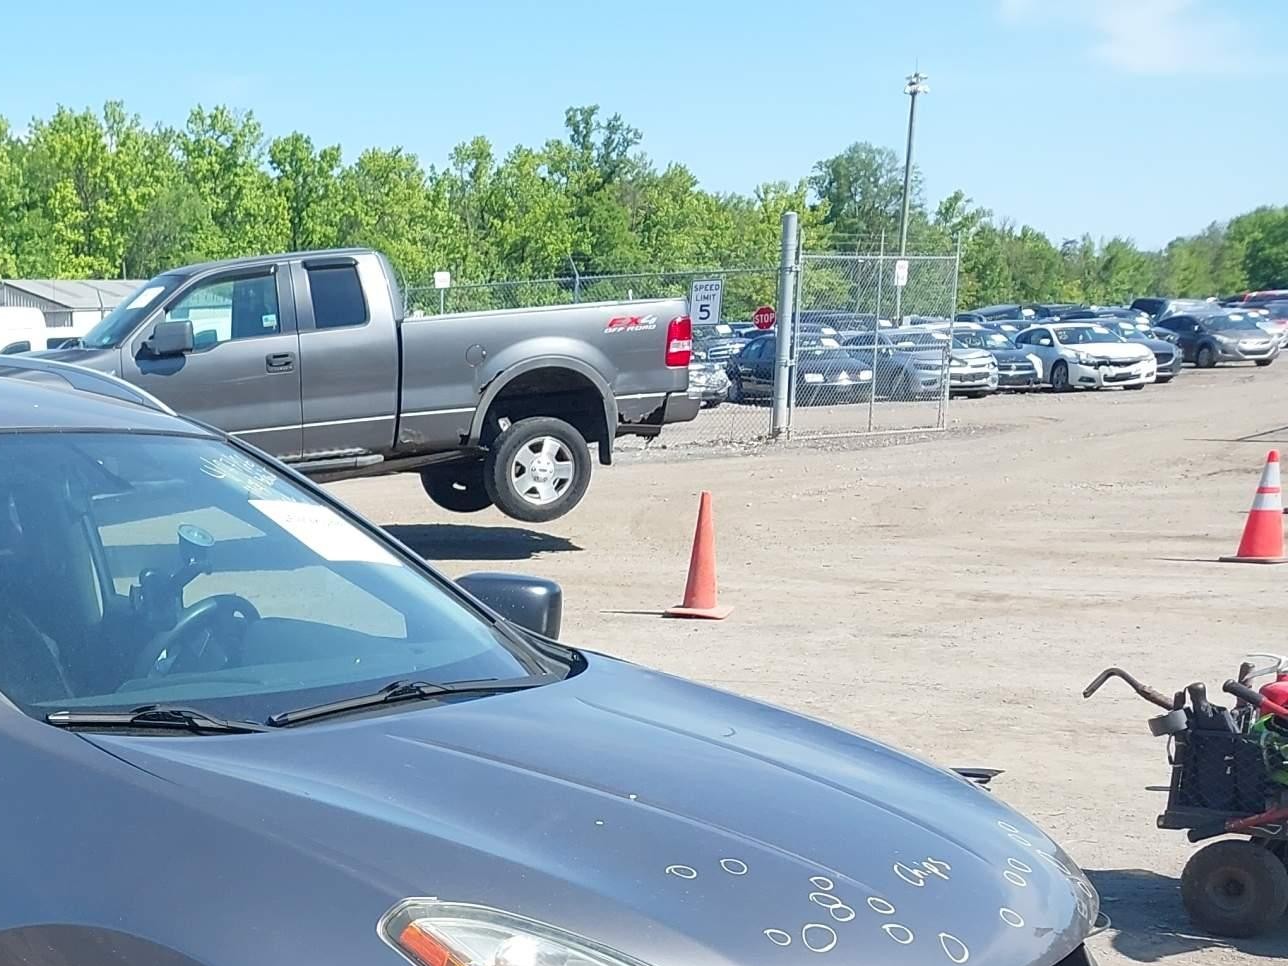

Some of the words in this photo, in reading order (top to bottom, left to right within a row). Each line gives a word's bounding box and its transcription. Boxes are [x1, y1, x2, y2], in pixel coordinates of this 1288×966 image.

[694, 283, 720, 292] SPEED
[696, 294, 716, 302] LIMIT
[699, 304, 711, 320] 5
[608, 314, 658, 328] FX4
[755, 312, 775, 325] STOP
[604, 326, 626, 334] OFF
[626, 324, 657, 332] ROAD
